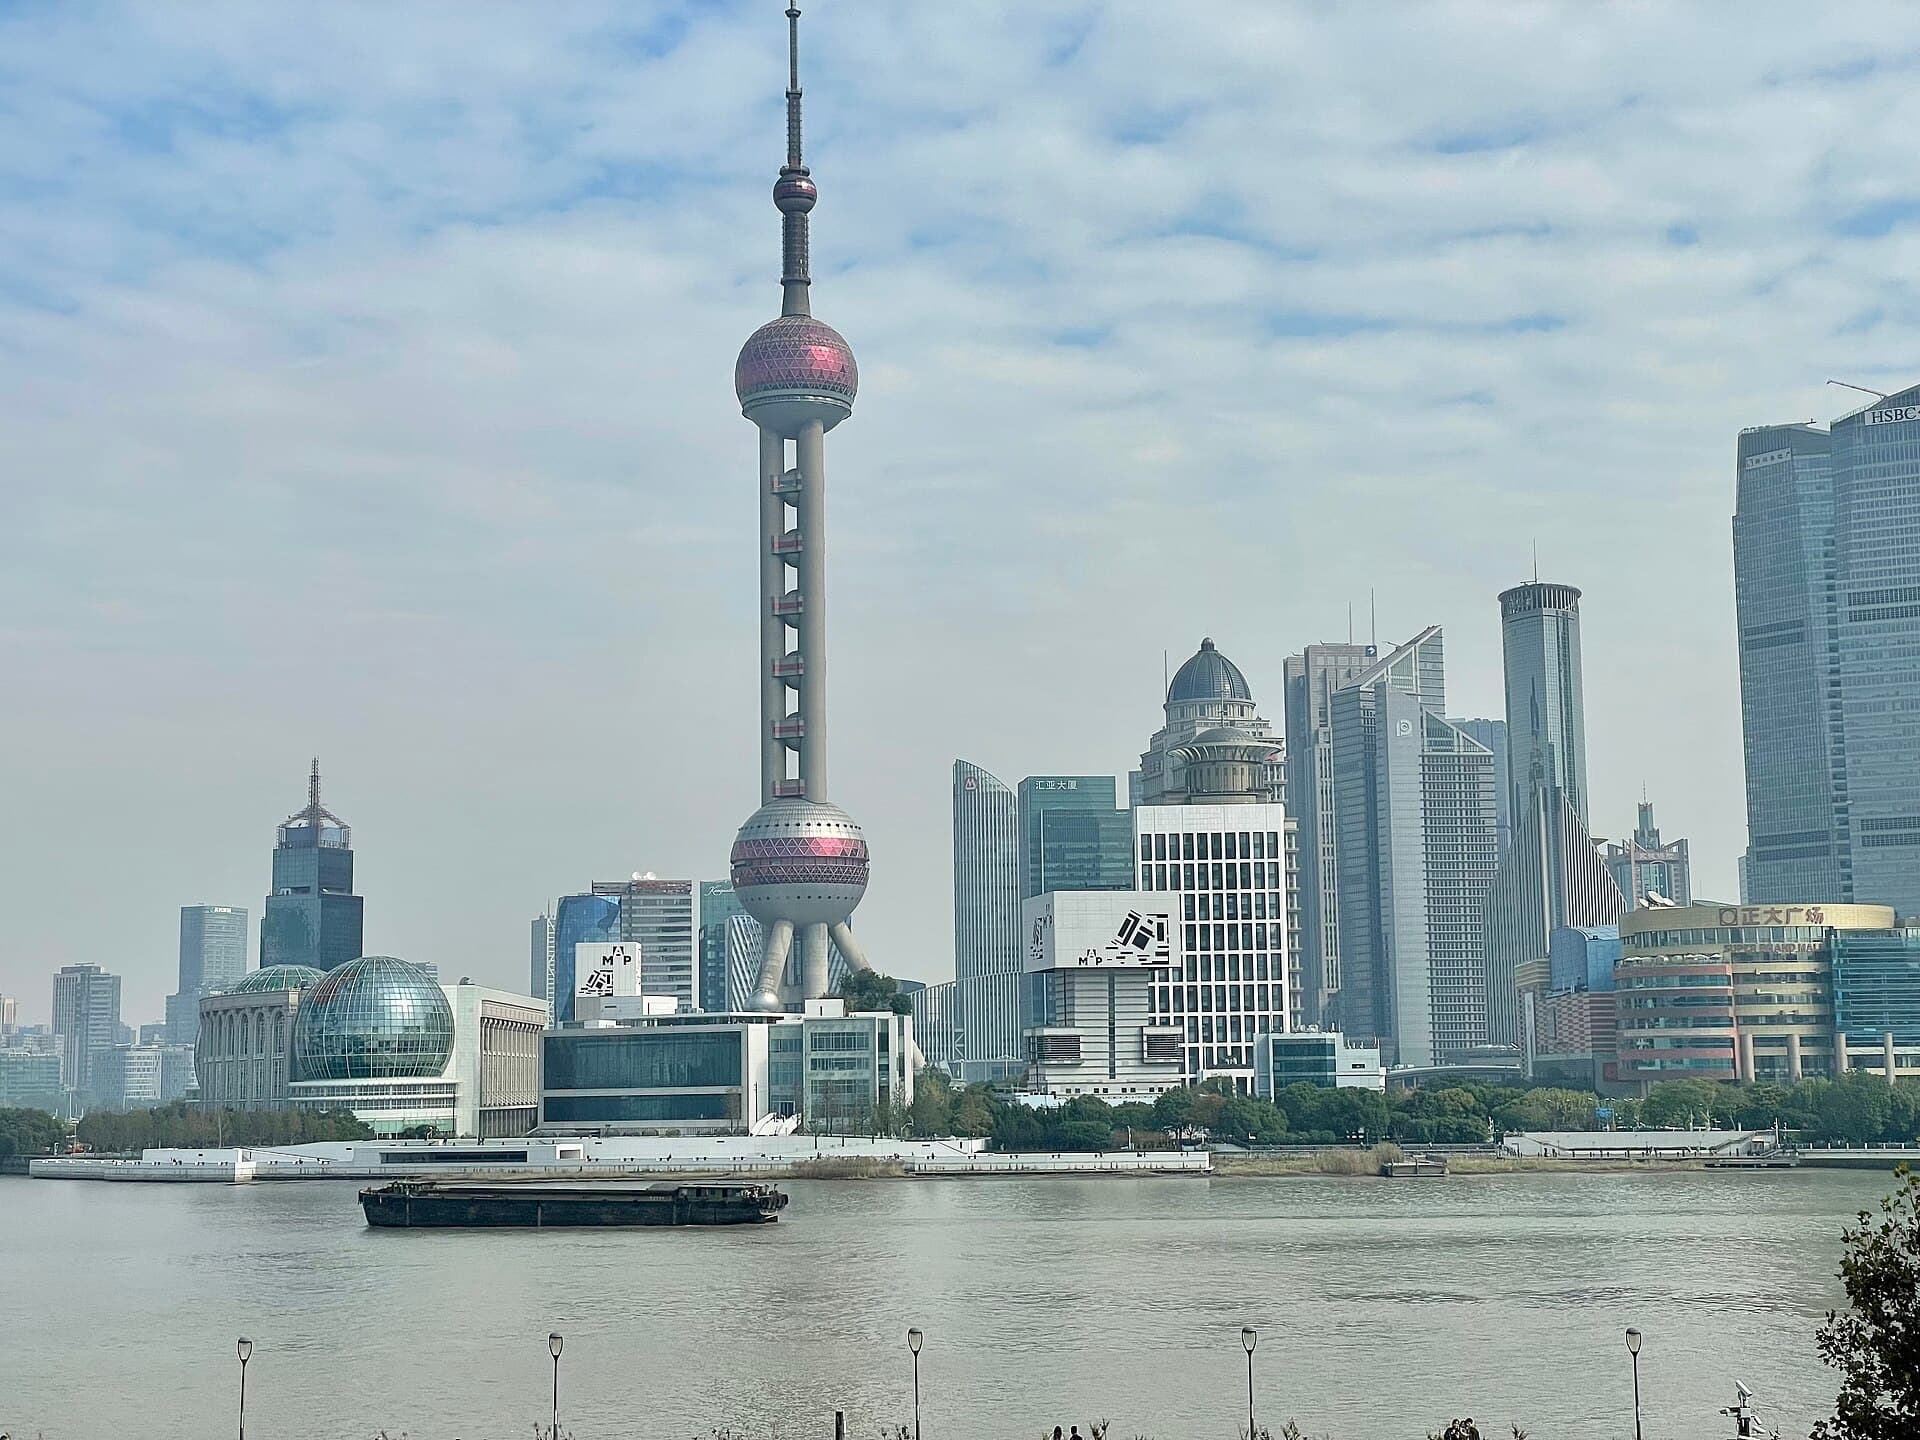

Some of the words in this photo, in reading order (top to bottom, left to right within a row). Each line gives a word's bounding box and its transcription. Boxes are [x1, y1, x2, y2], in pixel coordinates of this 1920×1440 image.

[1871, 407, 1916, 423] HSBC
[1035, 780, 1078, 790] 汇亚大厦
[1741, 906, 1824, 925] 正大广场
